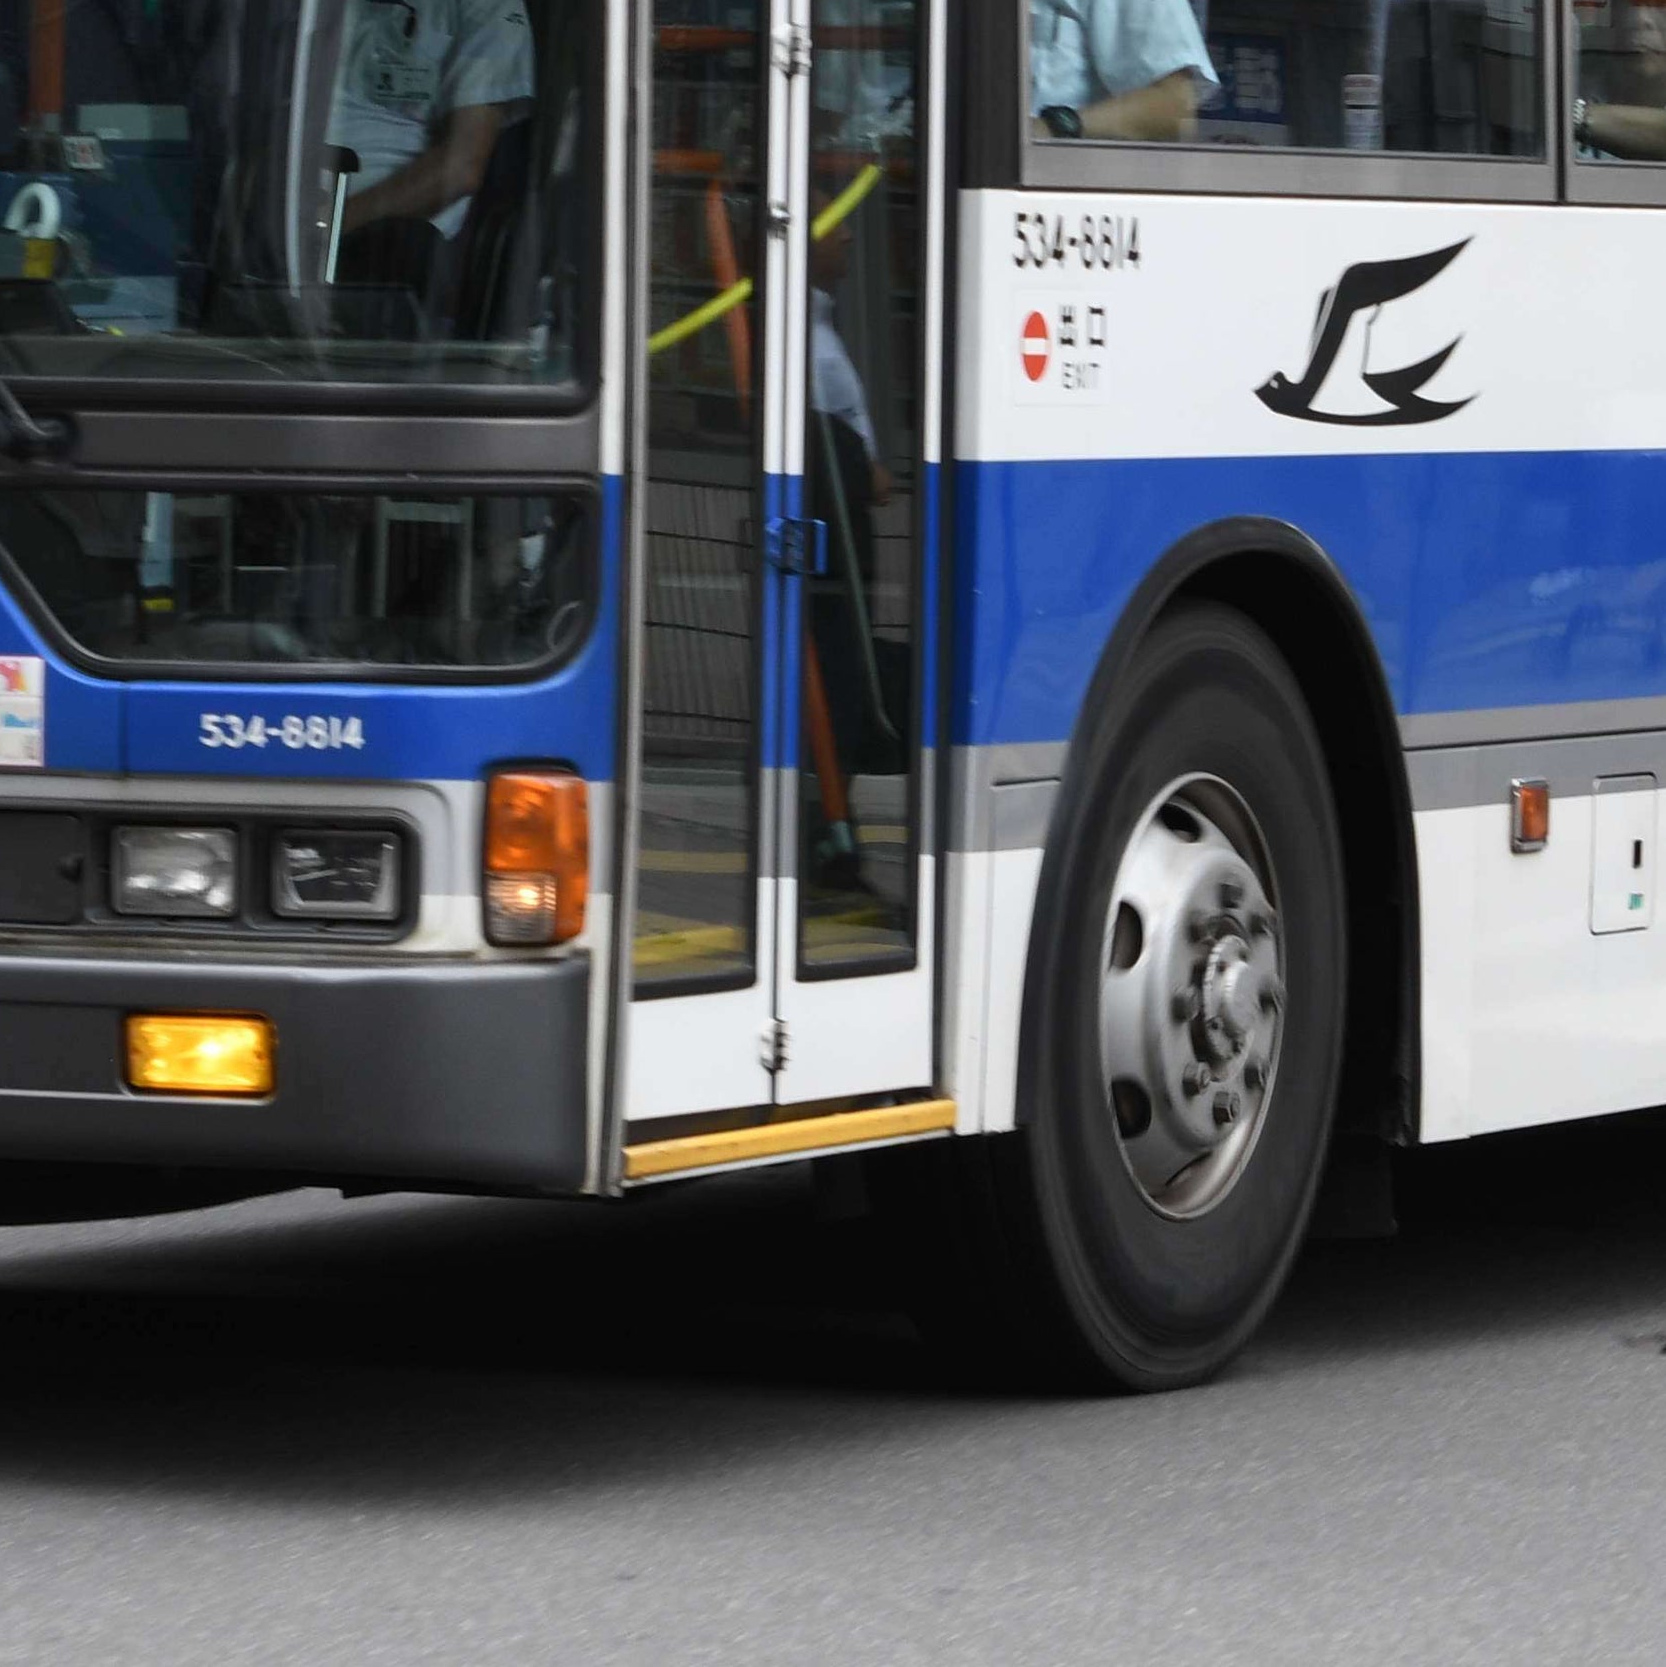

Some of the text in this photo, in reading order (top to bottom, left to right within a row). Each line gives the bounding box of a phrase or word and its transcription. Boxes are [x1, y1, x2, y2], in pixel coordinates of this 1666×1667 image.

[1013, 212, 1140, 270] 534-8814
[1057, 304, 1107, 348] 出口
[1063, 361, 1099, 390] EXIT
[199, 713, 366, 750] 534-8814
